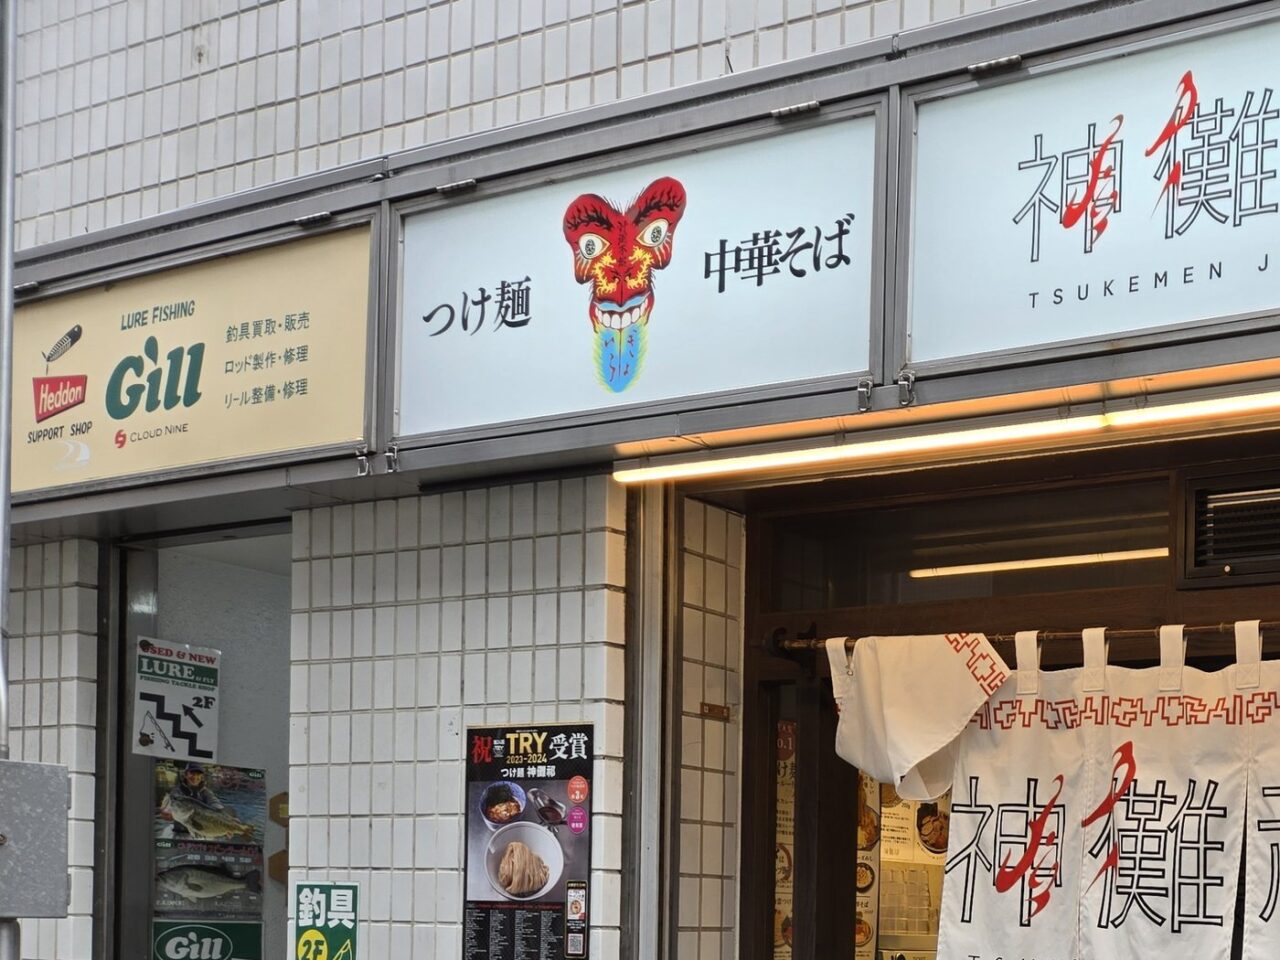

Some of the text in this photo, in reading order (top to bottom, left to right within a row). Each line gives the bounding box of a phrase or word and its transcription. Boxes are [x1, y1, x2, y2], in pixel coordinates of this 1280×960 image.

[703, 212, 856, 294] 中華そば
[1028, 261, 1223, 310] TSUKEMEN
[121, 300, 195, 331] LURE FISHING
[422, 275, 532, 337] つけ麺
[225, 311, 310, 344] 釣具買取・販売
[224, 345, 309, 374] ロッド製作・修理
[105, 335, 205, 420] Gill
[38, 381, 82, 415] Heddon
[224, 378, 309, 410] リール整備・修理
[27, 421, 93, 444] SUPPORT SHOP
[130, 423, 189, 443] CLOUD NINE
[140, 657, 195, 680] LURE
[189, 653, 217, 665] NEW
[192, 695, 216, 710] 2F
[472, 735, 493, 764] 祝
[506, 732, 548, 754] TRY
[549, 733, 588, 760] 受賞
[506, 754, 548, 765] 2023-2024
[298, 887, 356, 929] 釣具
[165, 931, 223, 960] Gill
